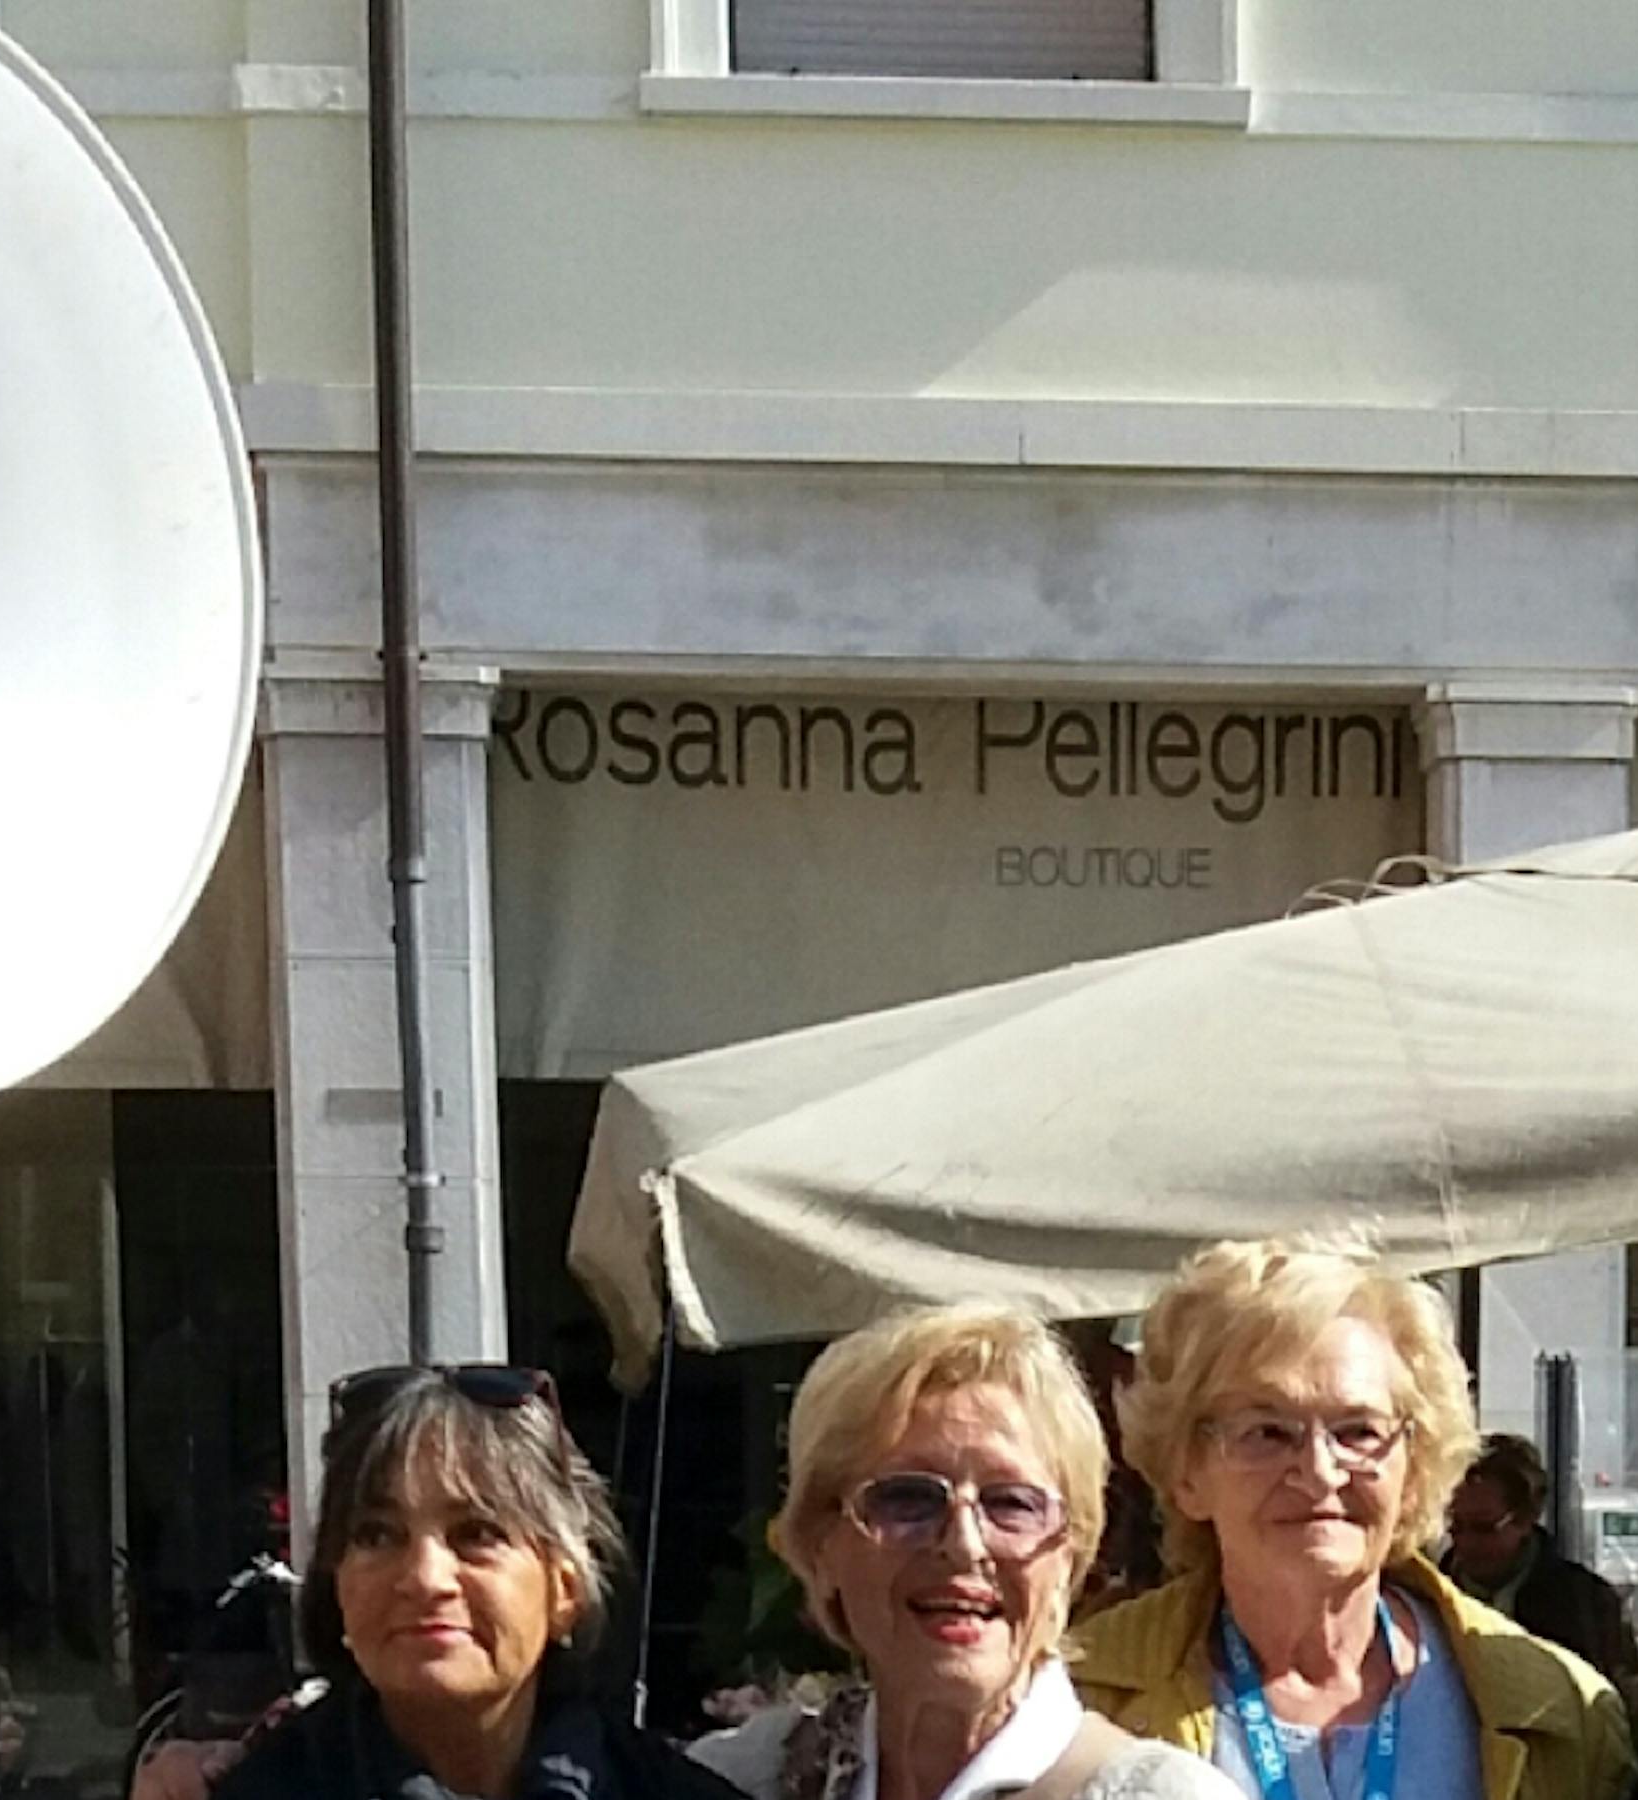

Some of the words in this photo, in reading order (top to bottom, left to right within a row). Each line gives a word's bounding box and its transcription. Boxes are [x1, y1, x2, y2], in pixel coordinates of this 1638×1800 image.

[492, 689, 922, 796] Rosanna
[973, 699, 1402, 823] Pellegrini
[994, 846, 1213, 889] BOUTIQUE
